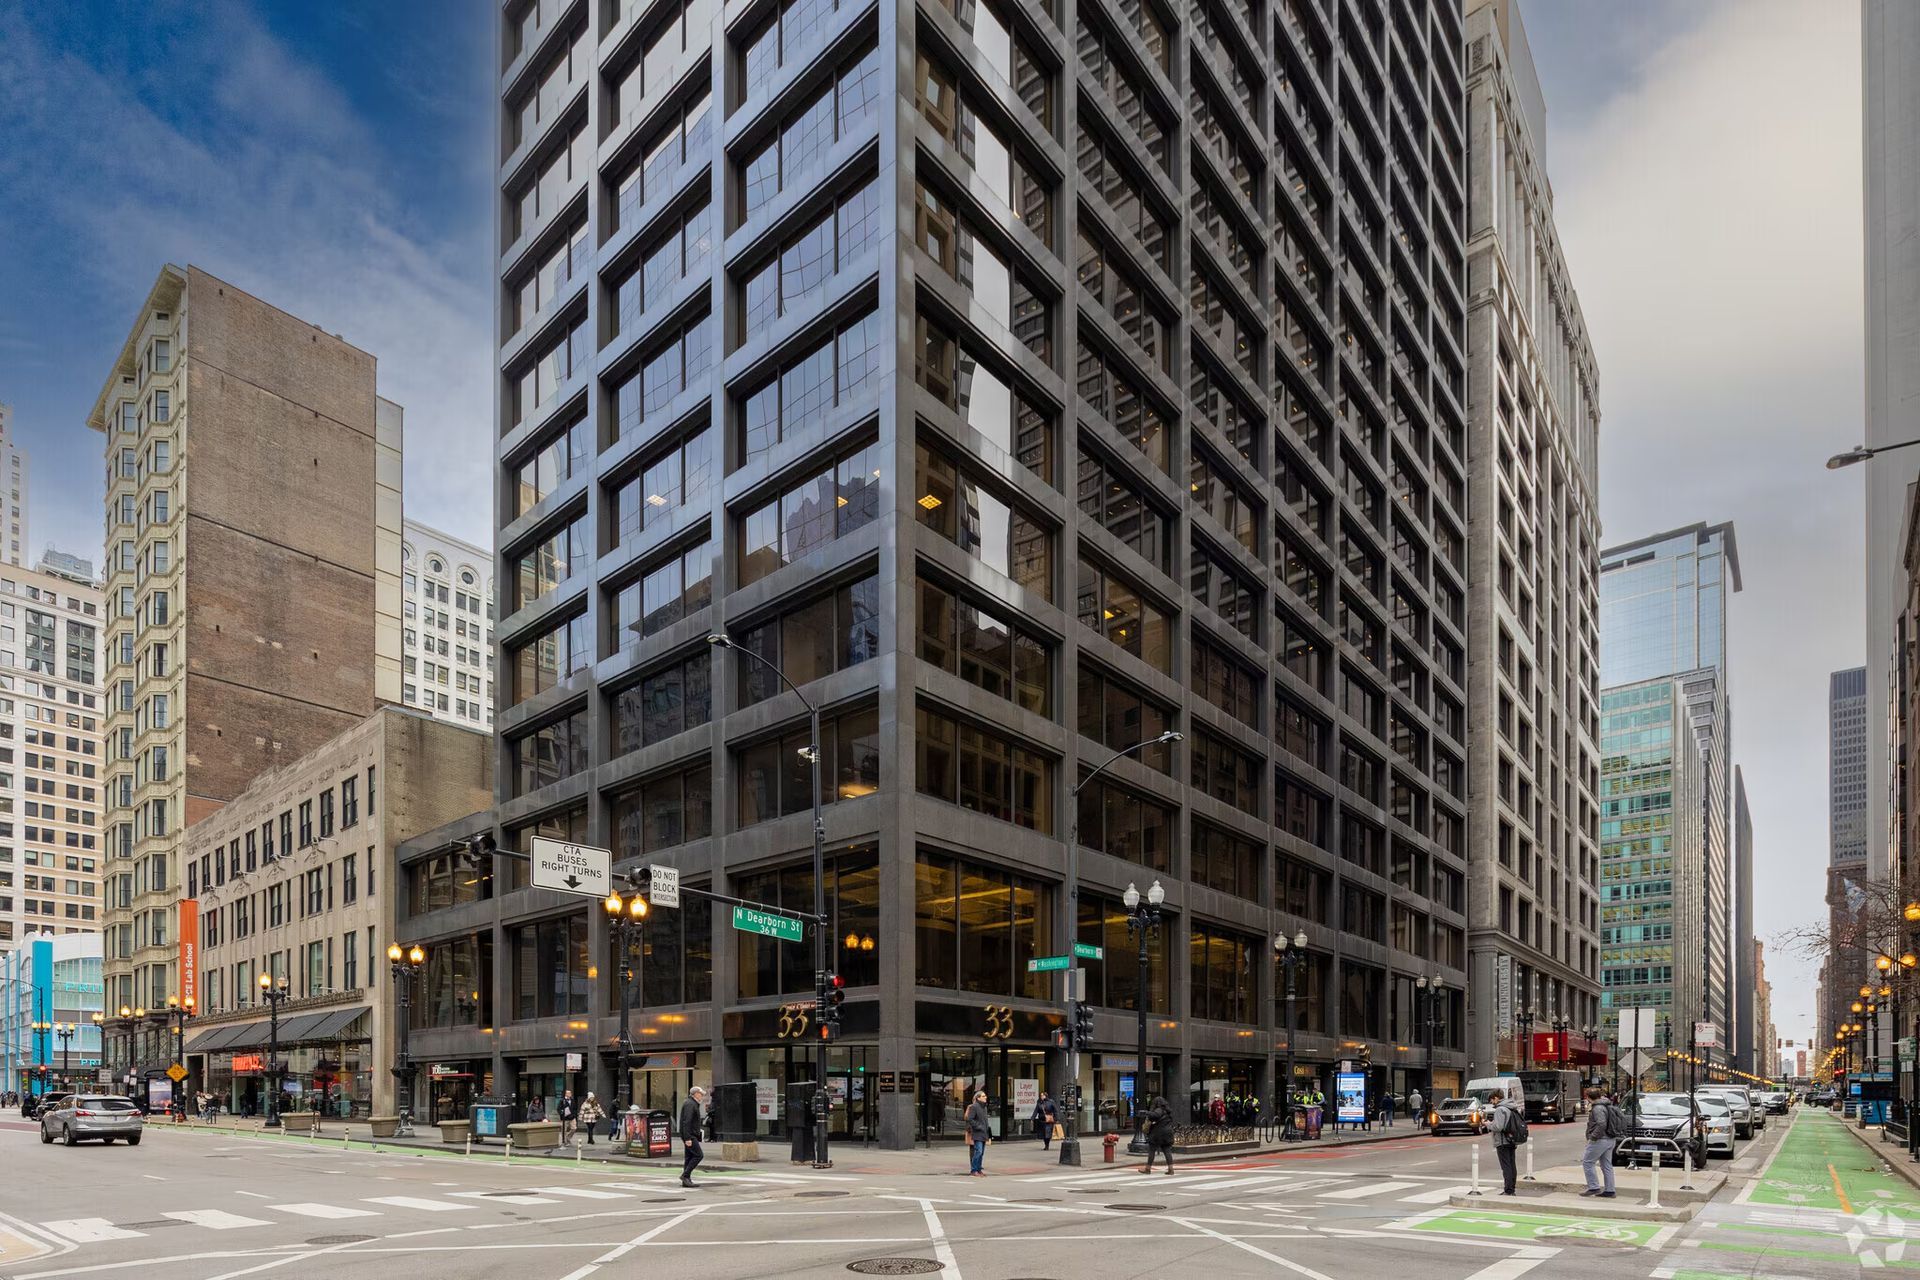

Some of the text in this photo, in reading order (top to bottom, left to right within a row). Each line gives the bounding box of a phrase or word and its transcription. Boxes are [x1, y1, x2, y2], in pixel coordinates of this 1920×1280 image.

[563, 845, 581, 855] CTA
[557, 853, 587, 866] BUSES
[541, 861, 602, 879] RIGHT TURNS
[652, 869, 676, 882] DO NOT
[653, 881, 676, 894] BLOCK
[653, 893, 677, 902] INTERSECTION
[736, 908, 800, 933] N Dearborn St
[760, 925, 770, 935] 36
[185, 943, 193, 968] School
[185, 969, 193, 983] Lab
[1500, 958, 1509, 1004] UNIVERSITY
[777, 1004, 808, 1038] 33
[984, 1004, 1014, 1039] 33
[1019, 1082, 1033, 1091] Layer
[1016, 1097, 1036, 1105] rewards
